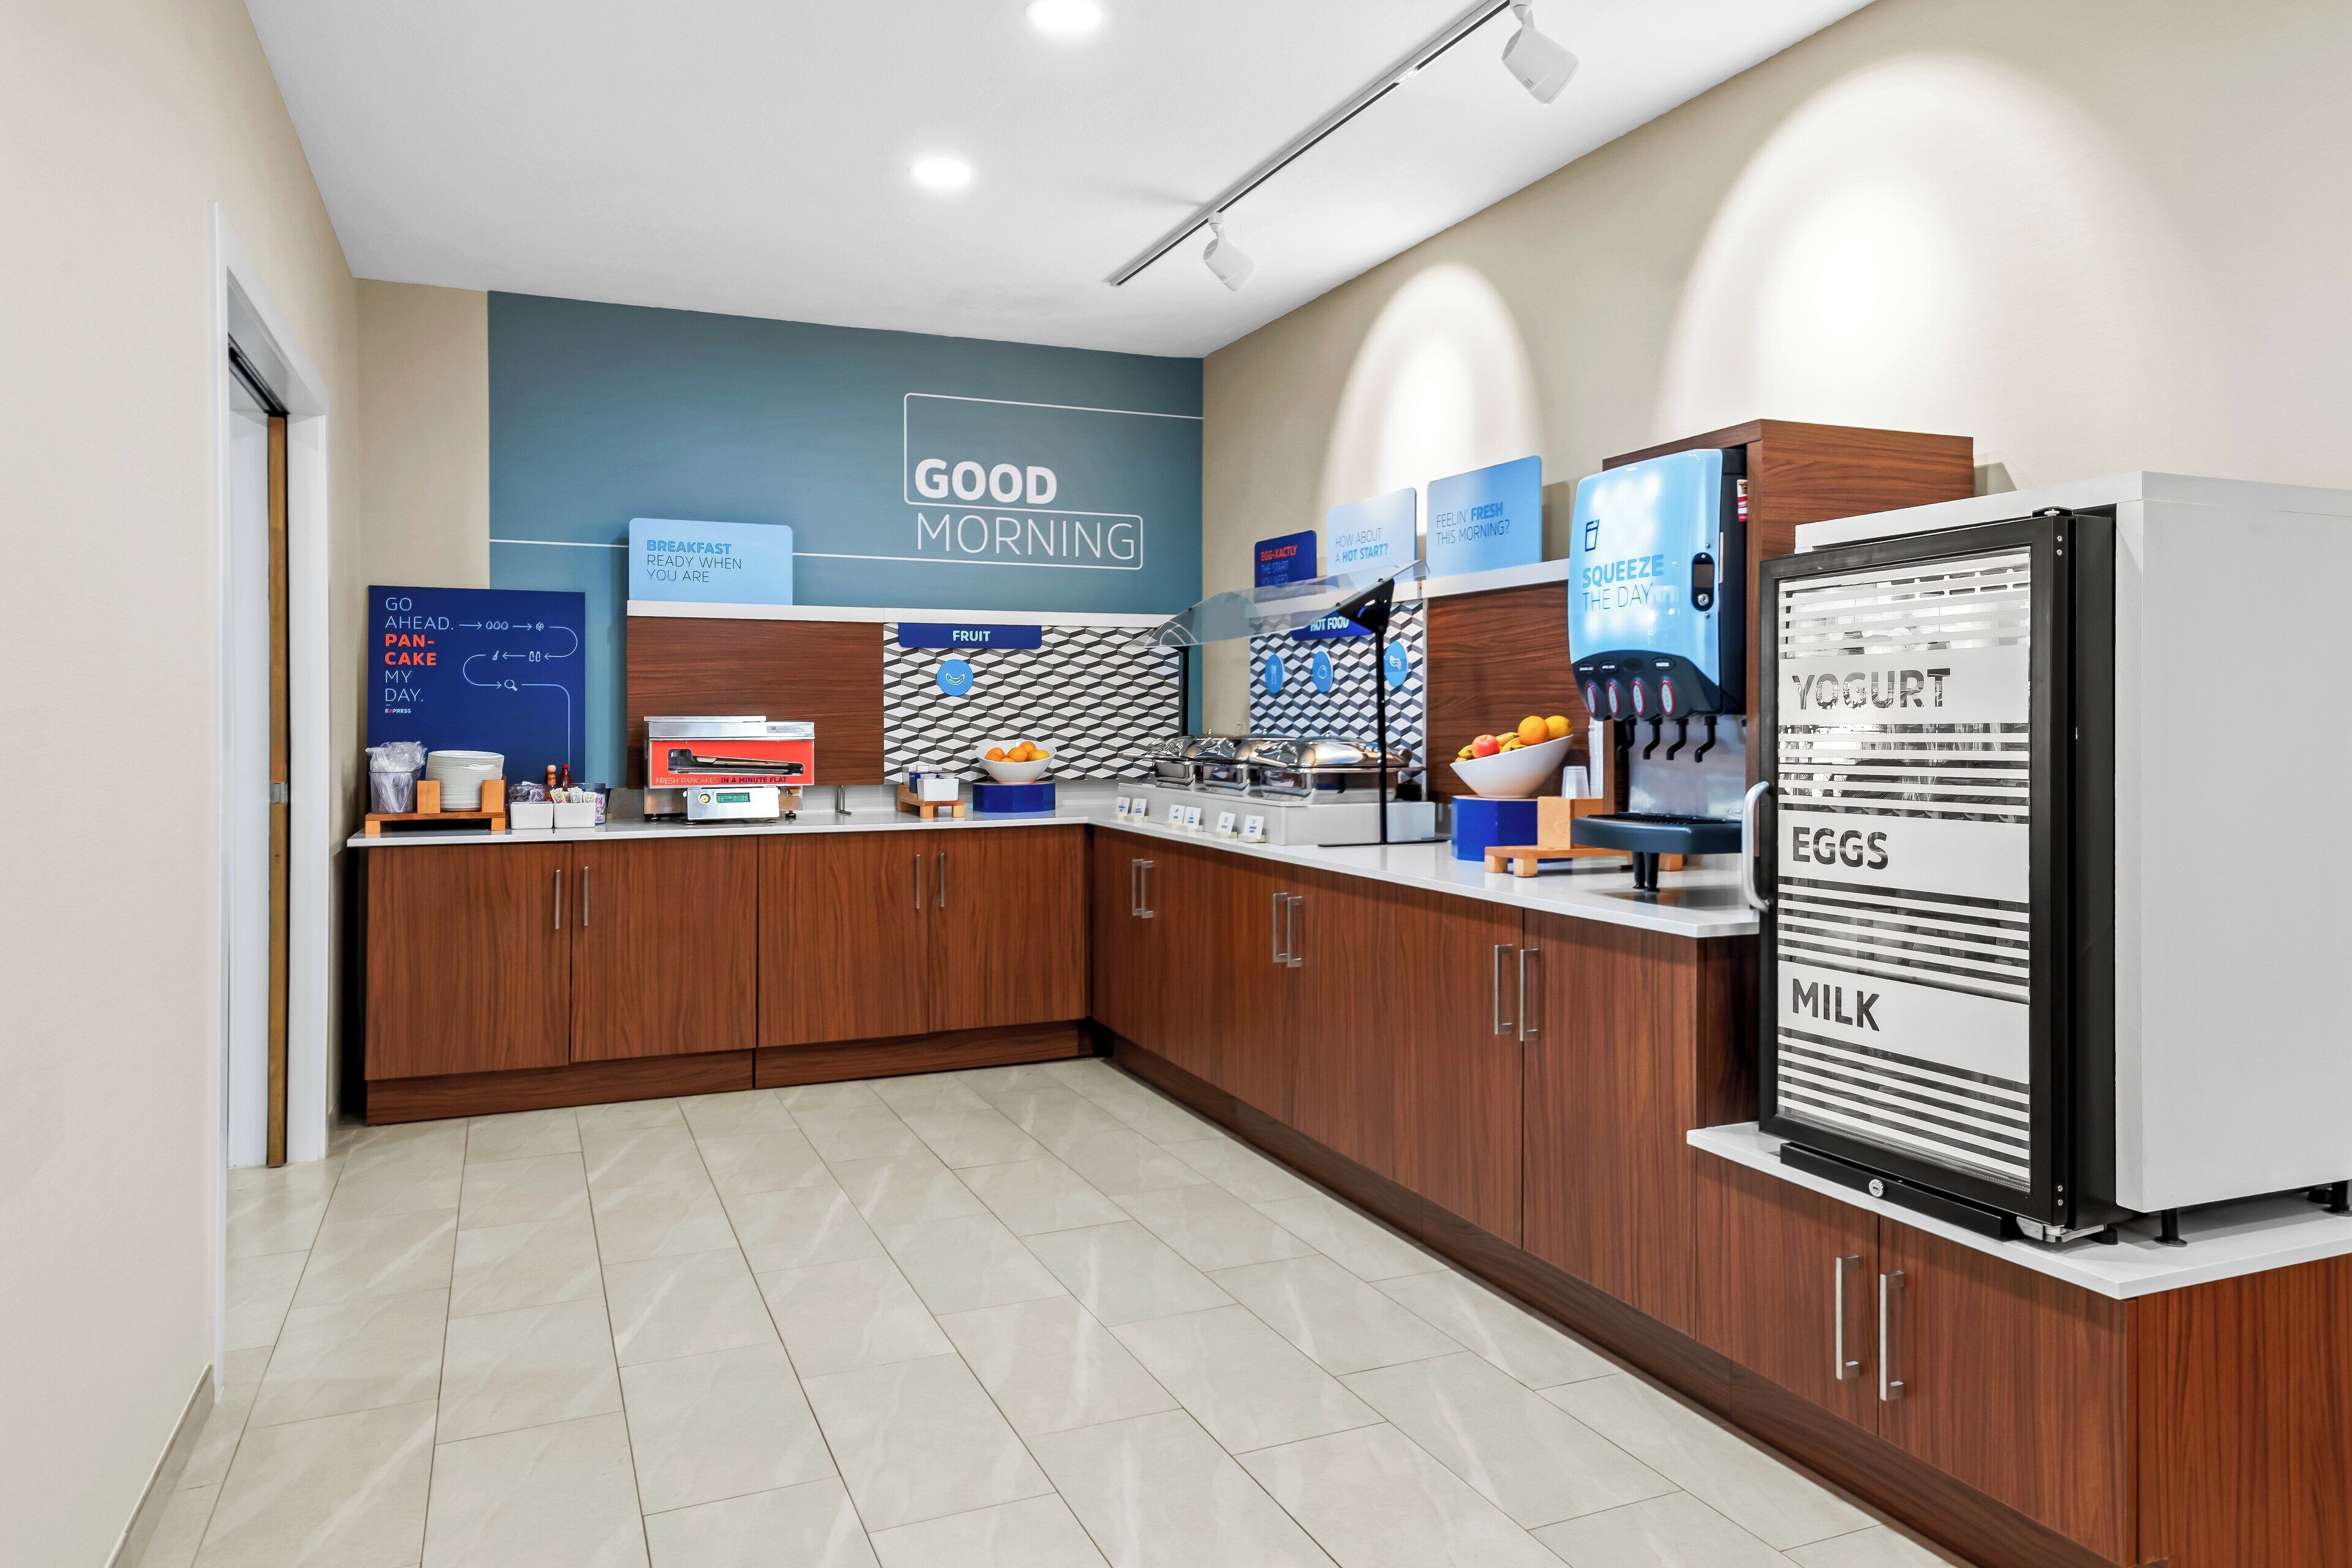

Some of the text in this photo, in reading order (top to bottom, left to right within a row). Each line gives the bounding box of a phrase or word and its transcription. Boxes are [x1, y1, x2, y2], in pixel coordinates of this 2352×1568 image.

[914, 458, 1057, 505] GOOD
[1436, 502, 1503, 528] FEELIN' FRESH
[917, 512, 1134, 560] MORNING
[1335, 527, 1382, 549] HOW ABOUT
[1436, 519, 1510, 546] THIS MORNING?
[647, 540, 731, 555] BREAKFAST
[1261, 545, 1298, 562] EGG-XACTLY
[1335, 543, 1388, 564] A HOT START?
[647, 554, 742, 570] READY WHEN
[647, 569, 709, 582] YOU ARE
[1582, 554, 1664, 588] SQUEEZE
[385, 597, 412, 611] GO
[1582, 582, 1653, 612] THE DAY
[385, 616, 454, 630] AHEAD.
[1310, 616, 1349, 632] HOT FOOD
[385, 633, 435, 647] PAN-
[952, 630, 991, 642] FRUIT
[385, 652, 437, 666] CAKE
[385, 670, 412, 683] MY
[385, 688, 423, 702] DAY.
[1792, 668, 1951, 710] YOGURT
[1793, 826, 1888, 870] EGGS
[1792, 978, 1880, 1032] MILK
